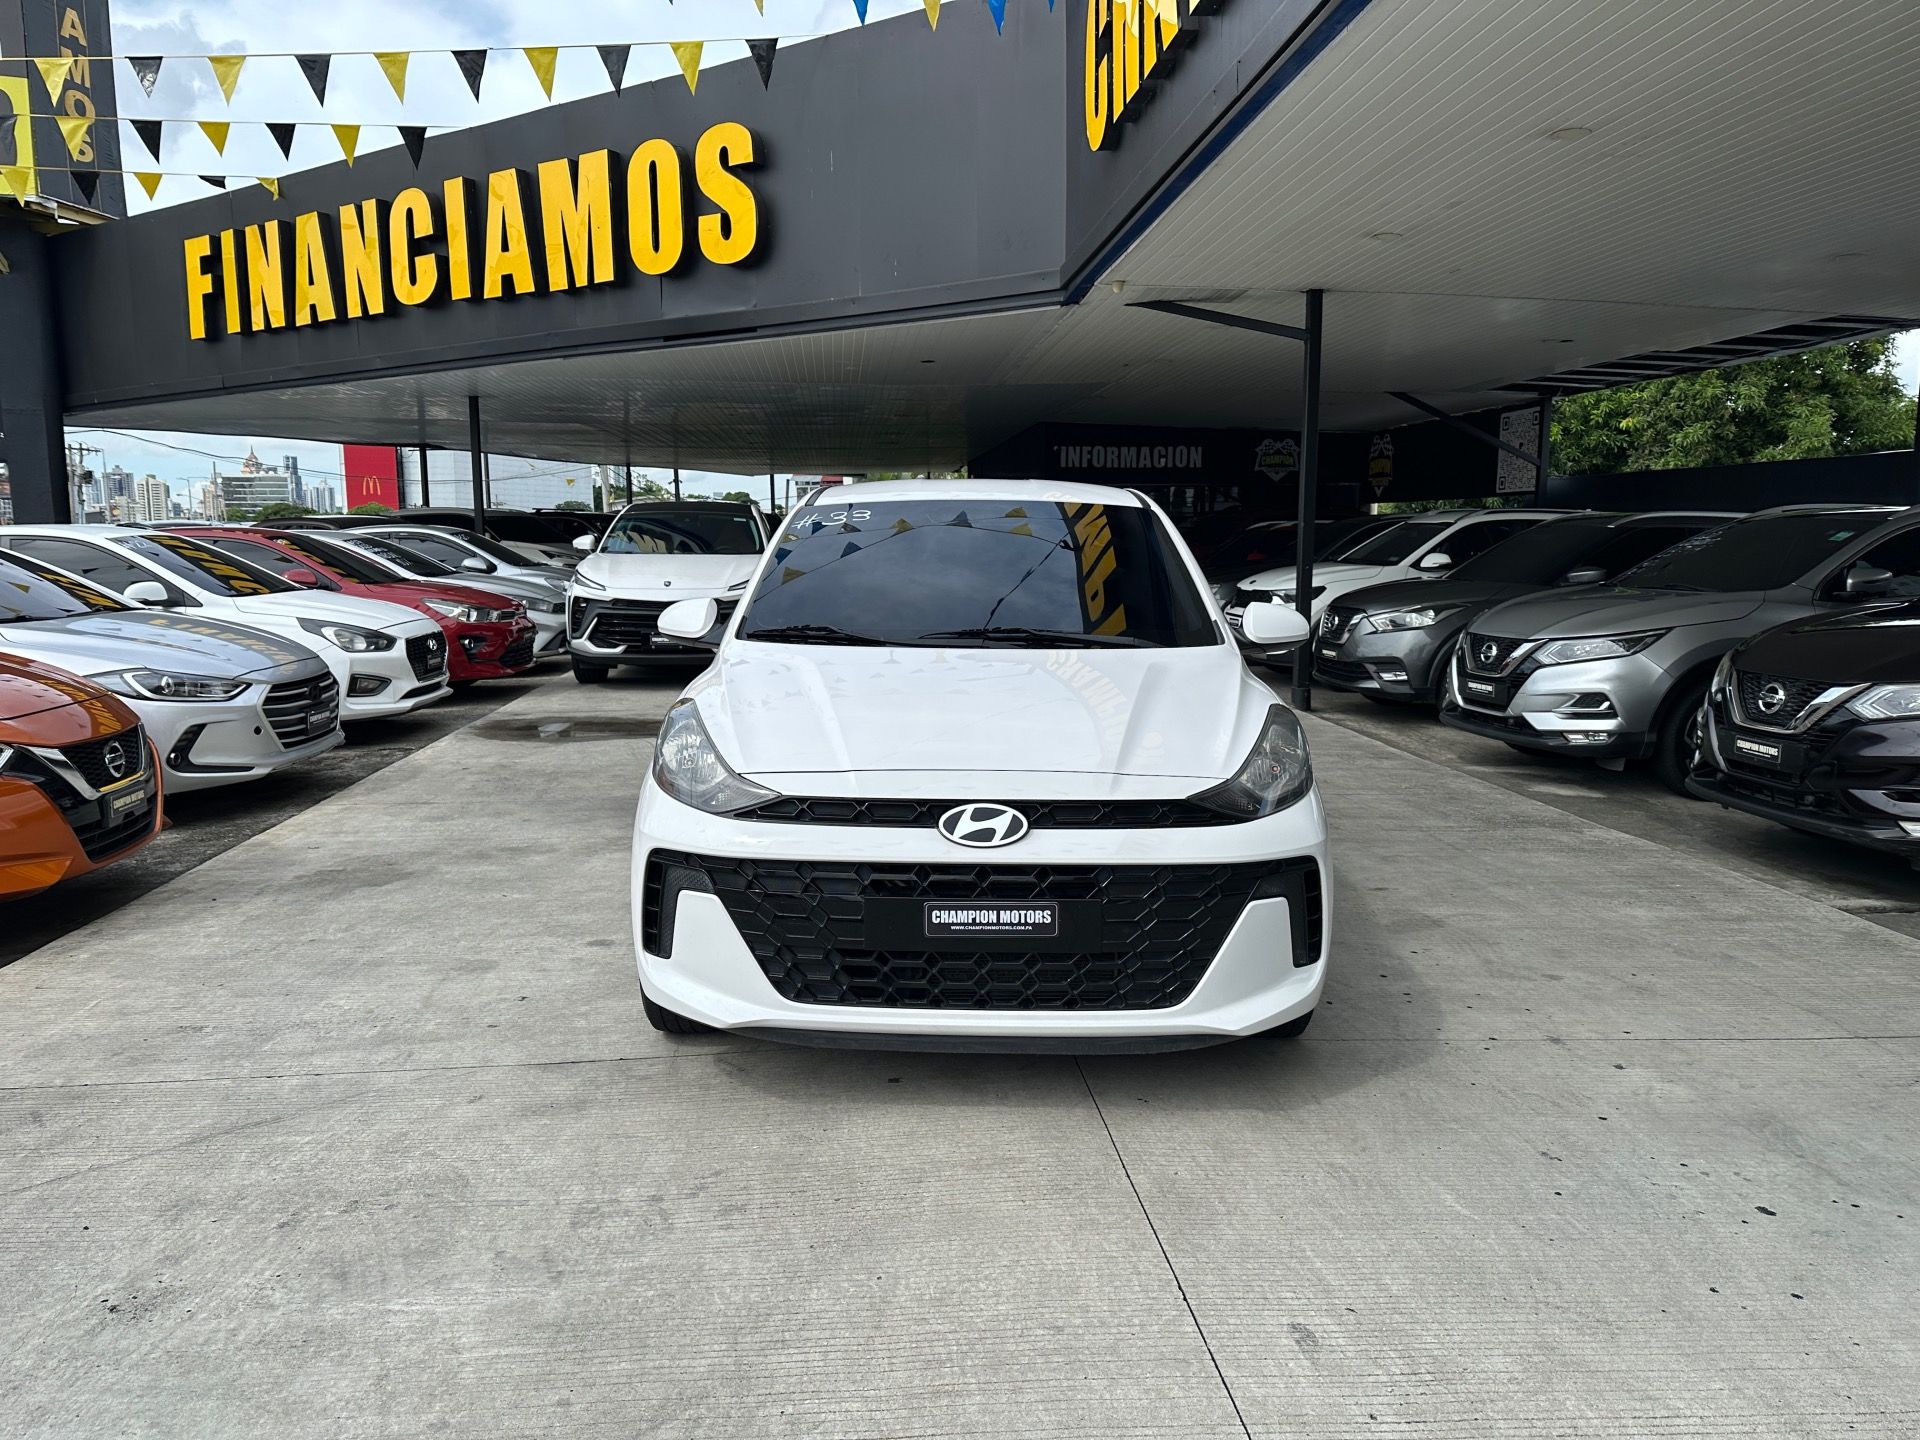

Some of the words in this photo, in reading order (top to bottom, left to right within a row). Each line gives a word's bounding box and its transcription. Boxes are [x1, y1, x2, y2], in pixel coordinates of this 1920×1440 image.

[184, 121, 757, 341] FINANCIAMOS
[1059, 446, 1203, 469] INFORMACION
[1736, 739, 1760, 752] CHAMPION
[1759, 744, 1779, 756] MOTORS
[931, 910, 997, 924] CHAMPION
[999, 910, 1052, 924] MOTORS
